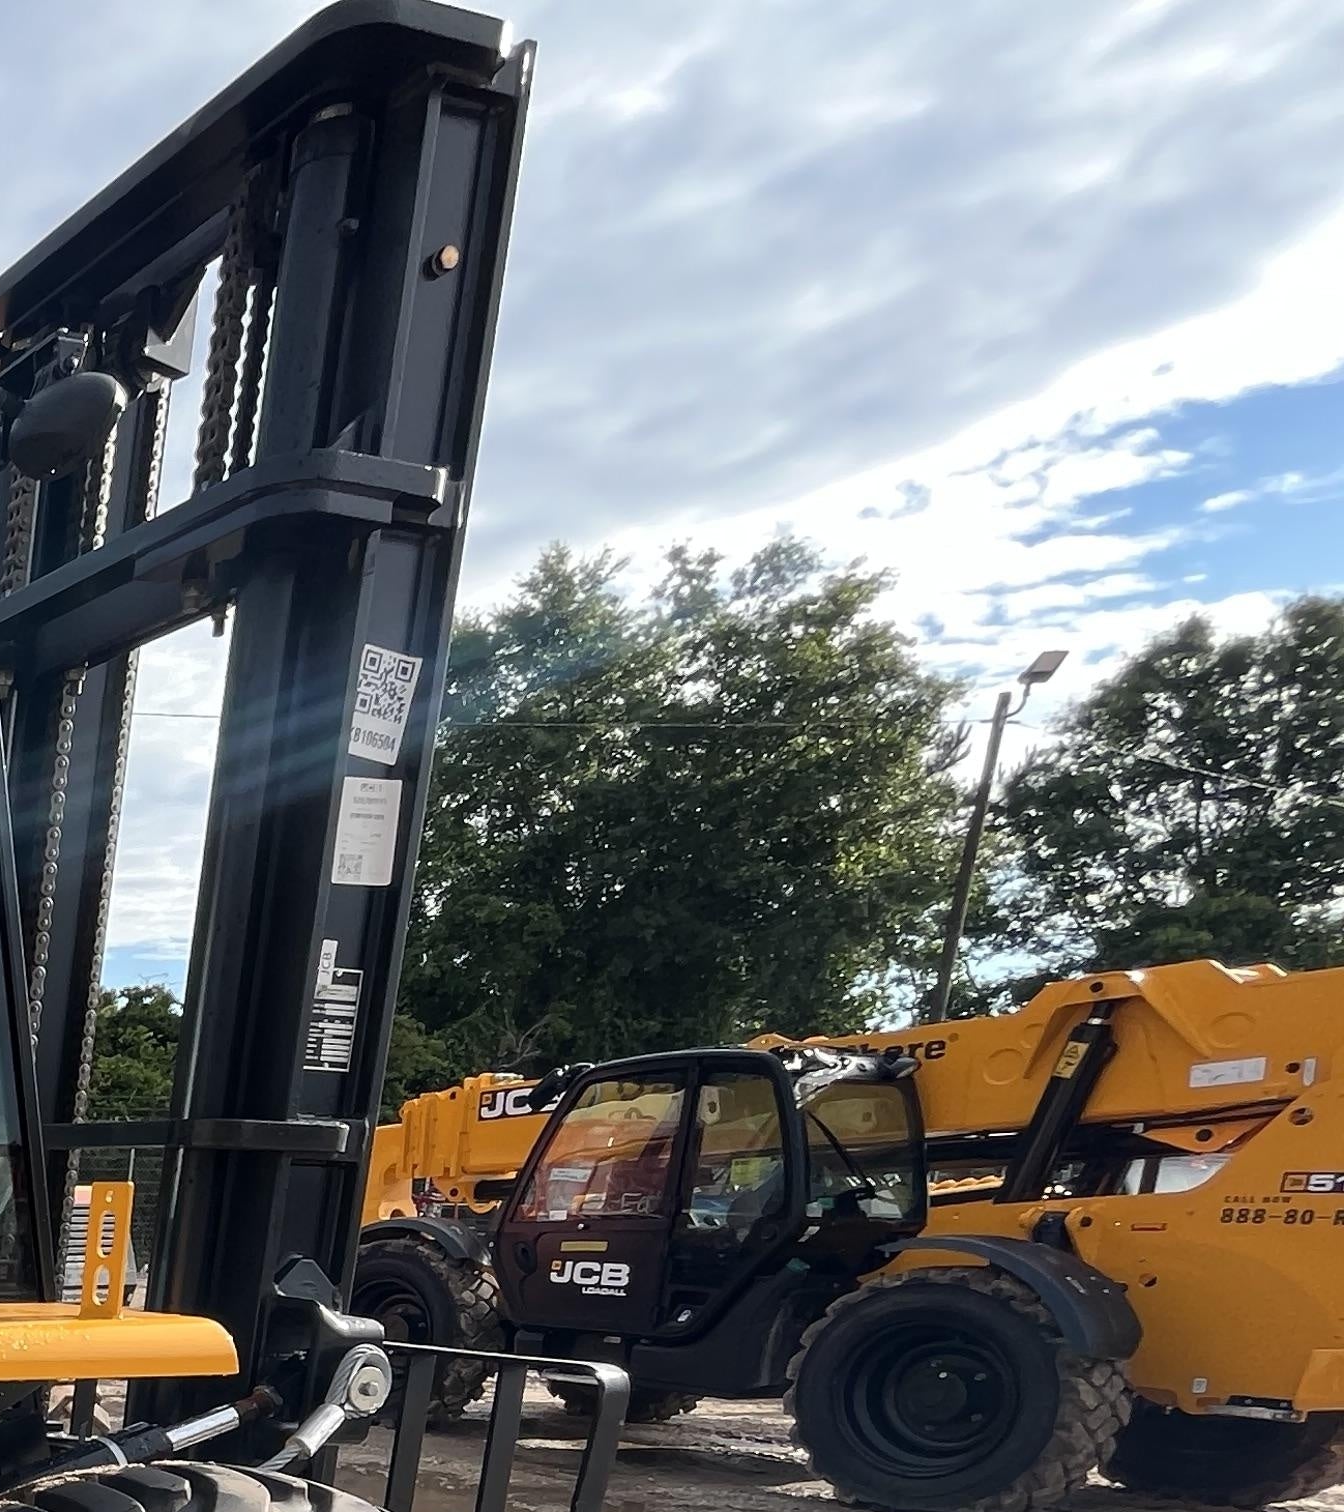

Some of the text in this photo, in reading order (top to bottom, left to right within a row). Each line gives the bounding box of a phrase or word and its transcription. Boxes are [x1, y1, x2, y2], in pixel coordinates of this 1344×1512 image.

[320, 952, 332, 977] JCB
[549, 1261, 631, 1286] JCB
[581, 1286, 627, 1296] LOADALL
